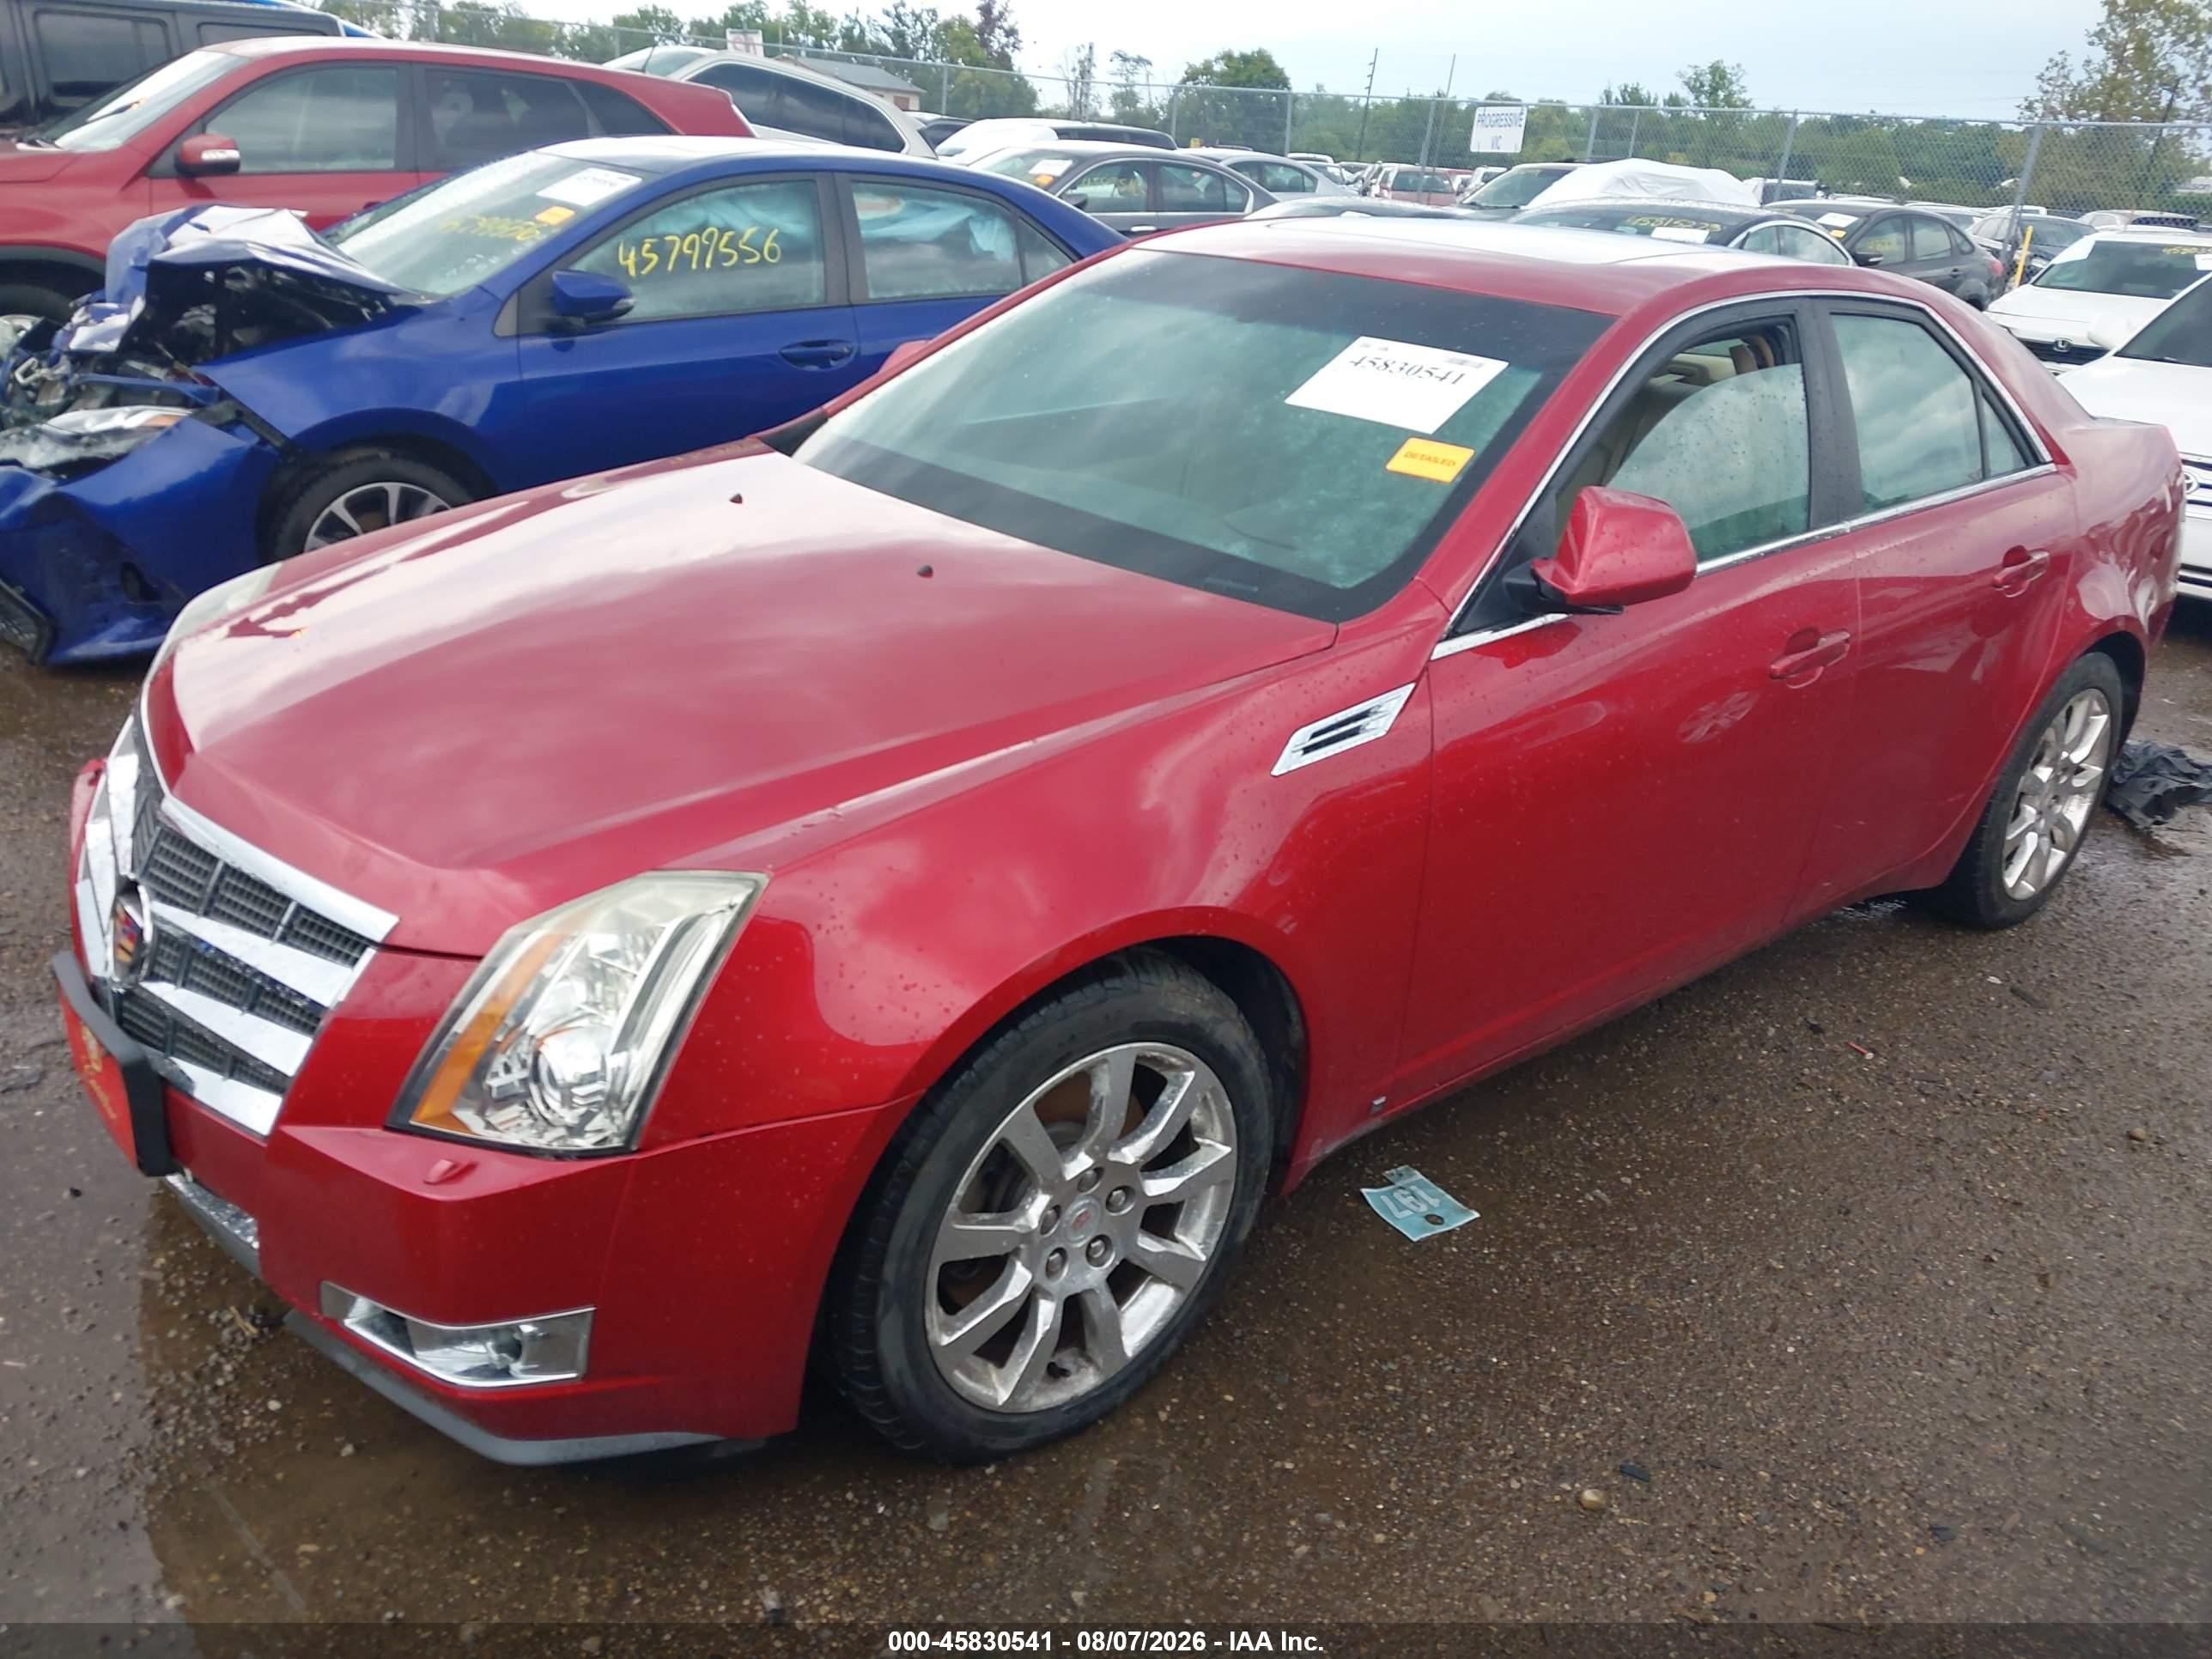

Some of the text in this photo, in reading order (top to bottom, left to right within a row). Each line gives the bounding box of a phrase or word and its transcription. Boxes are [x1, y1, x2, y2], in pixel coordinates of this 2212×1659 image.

[1477, 112, 1524, 128] PROGRESSIVE
[617, 226, 782, 277] 45799556
[1349, 355, 1467, 385] 45830541
